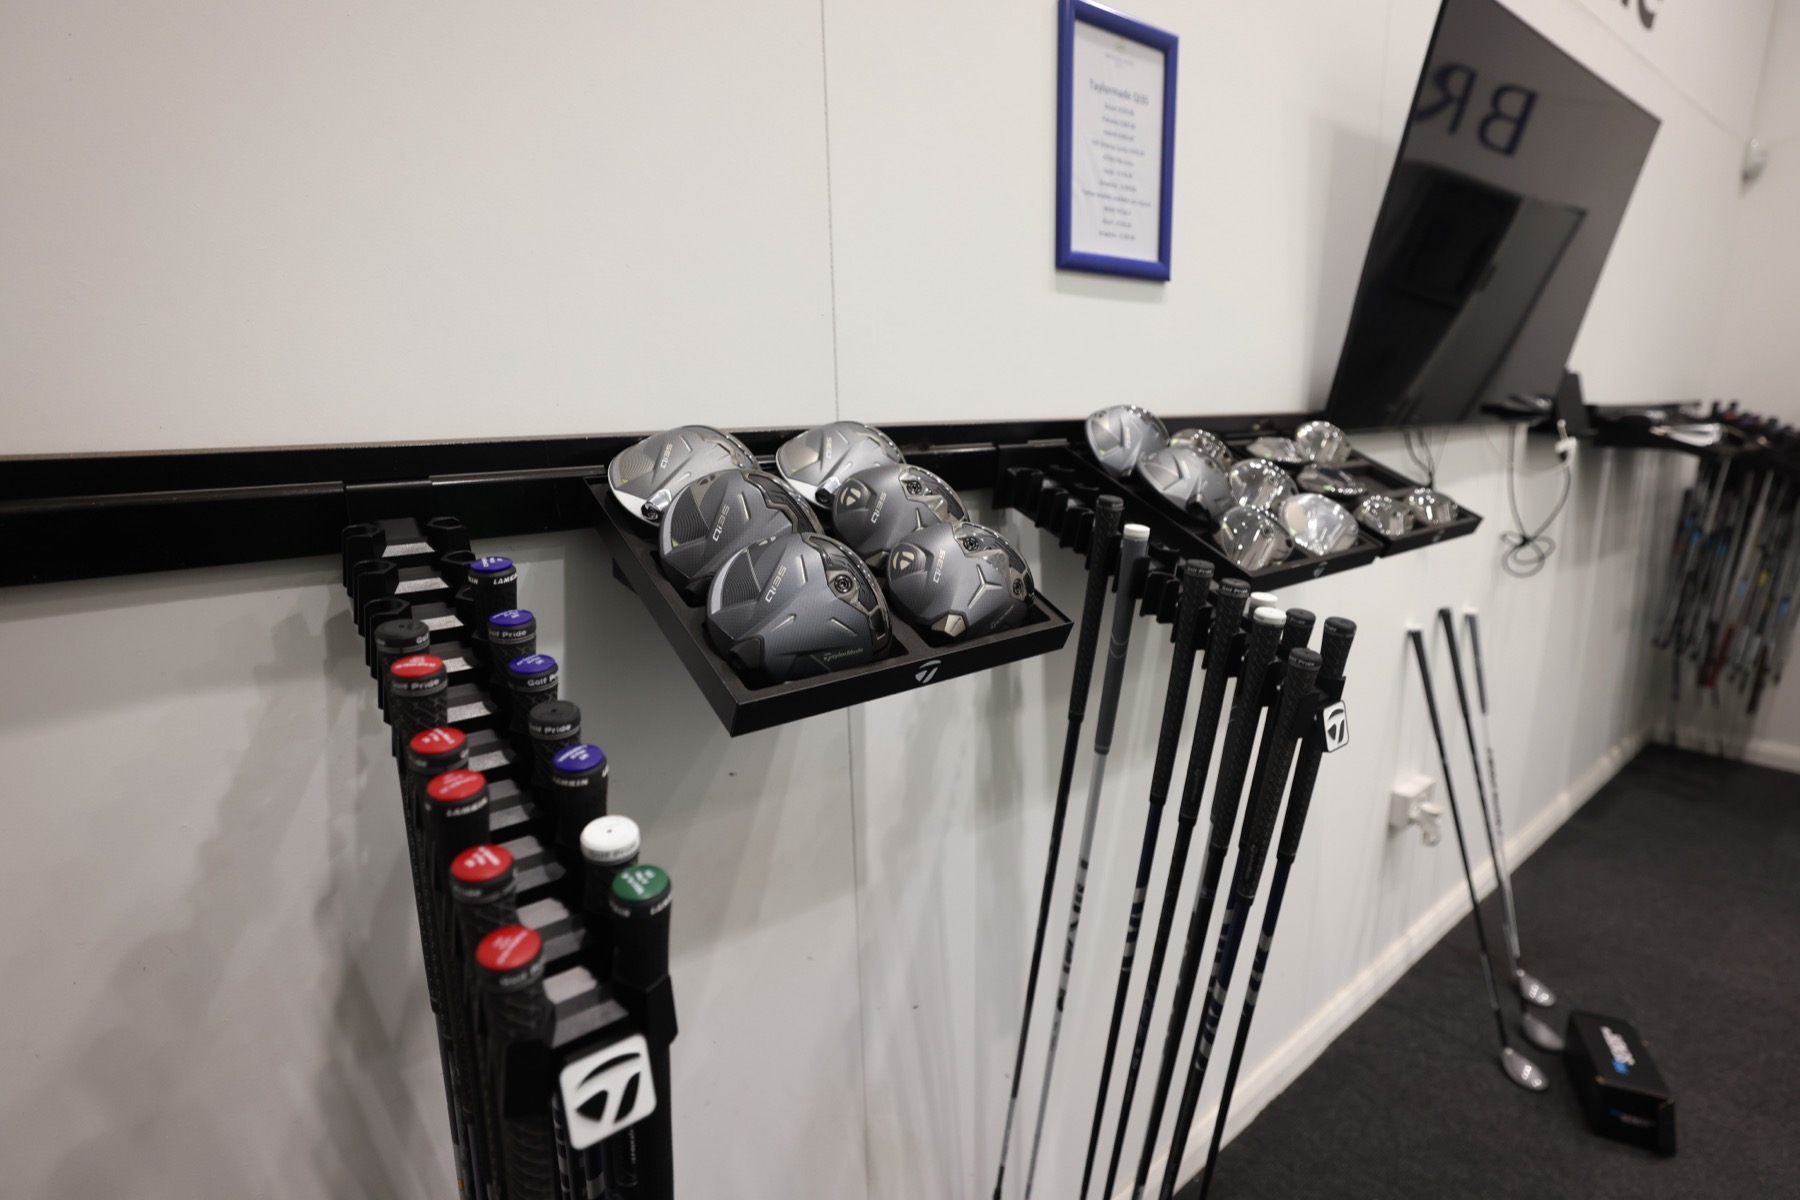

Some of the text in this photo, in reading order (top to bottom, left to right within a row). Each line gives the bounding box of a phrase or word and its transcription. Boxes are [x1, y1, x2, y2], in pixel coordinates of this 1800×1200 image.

[660, 443, 673, 469] Qi35
[870, 490, 887, 524] Qi35
[712, 504, 731, 542] Qi35
[493, 572, 517, 585] LAMK
[932, 549, 946, 583] Qi35
[764, 564, 787, 603] Qi35
[502, 630, 527, 638] Pride
[527, 676, 547, 687] Golf
[544, 723, 572, 734] Pride
